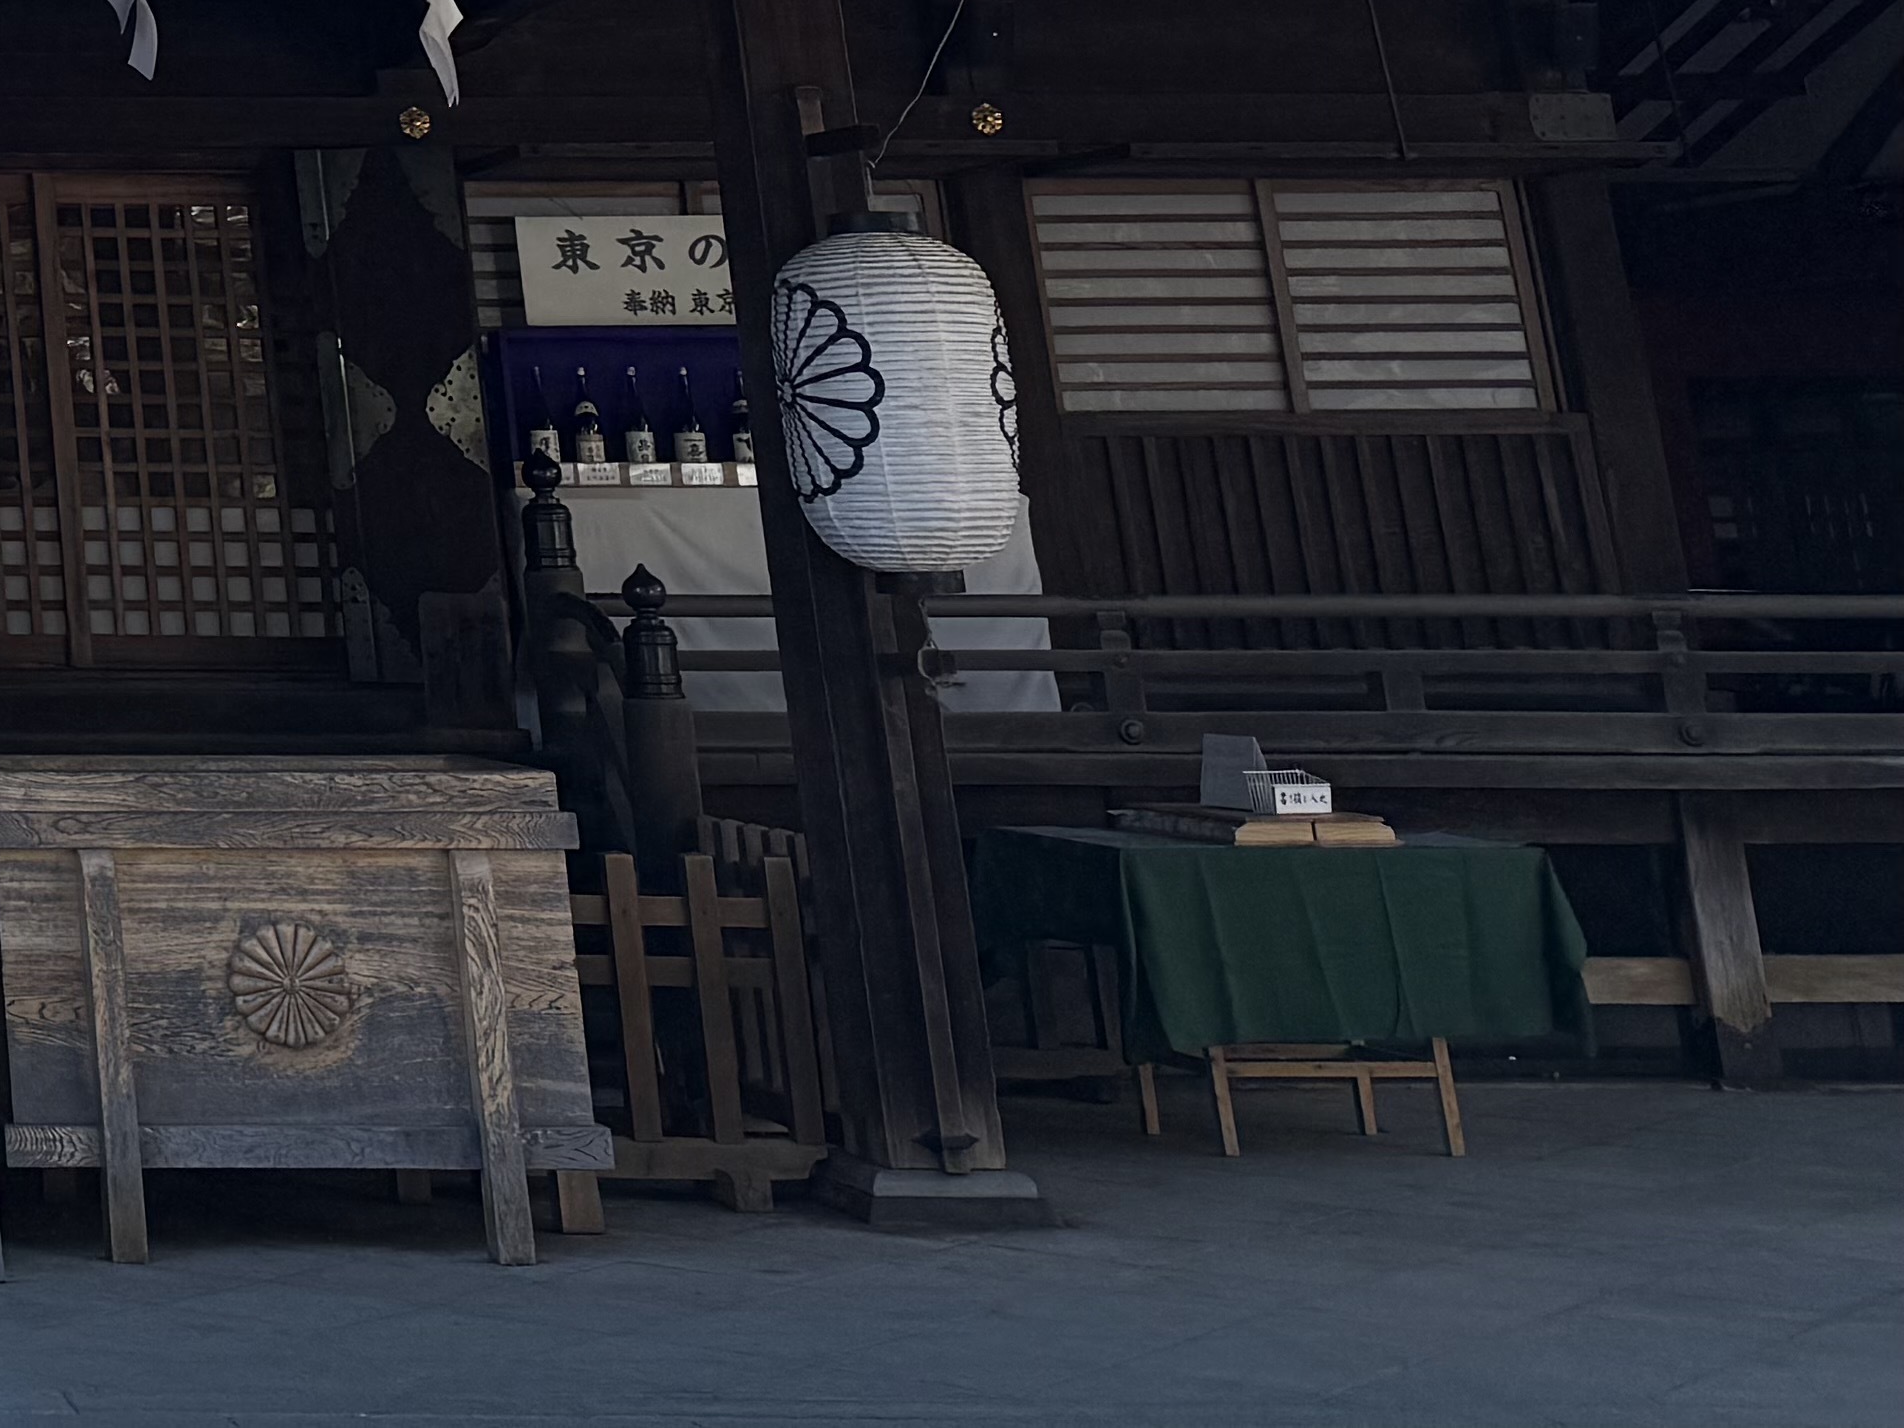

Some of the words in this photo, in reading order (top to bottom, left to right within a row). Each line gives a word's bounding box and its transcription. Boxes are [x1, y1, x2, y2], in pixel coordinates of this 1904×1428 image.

[552, 229, 728, 275] 東京の
[622, 289, 677, 316] 奉納
